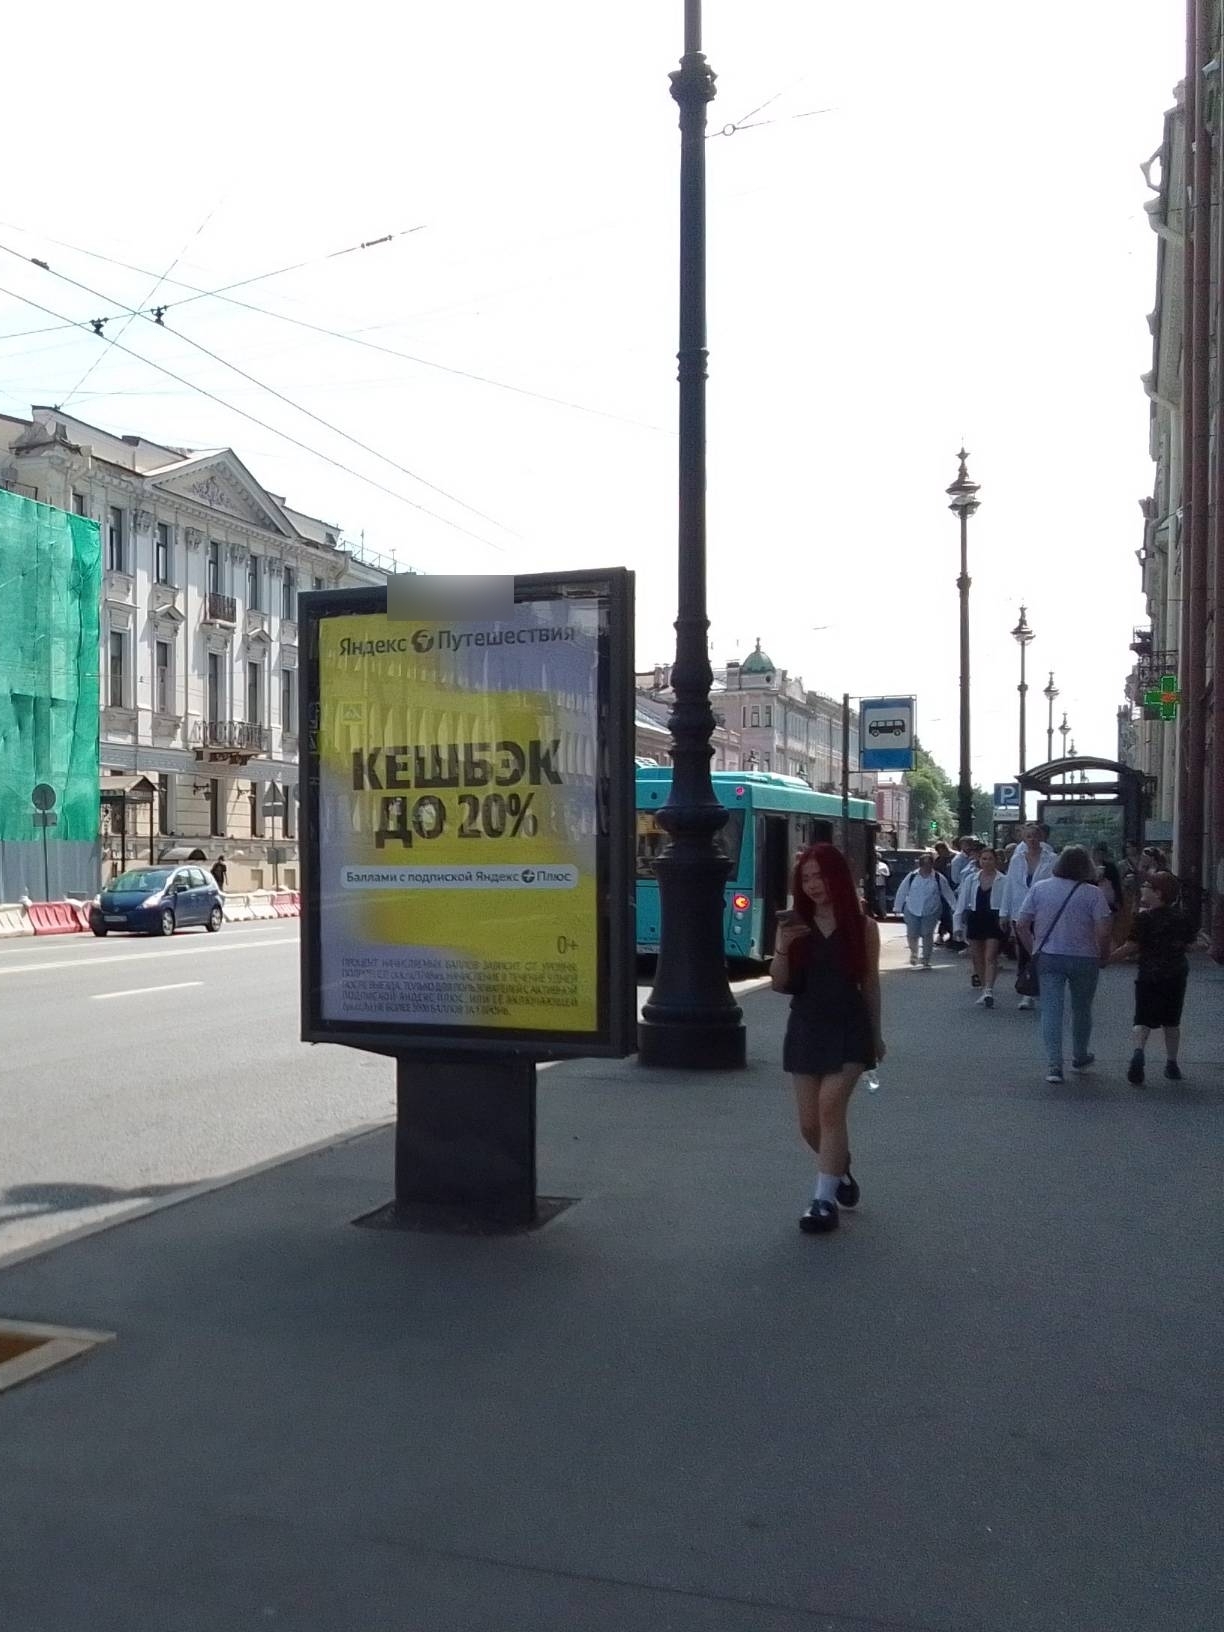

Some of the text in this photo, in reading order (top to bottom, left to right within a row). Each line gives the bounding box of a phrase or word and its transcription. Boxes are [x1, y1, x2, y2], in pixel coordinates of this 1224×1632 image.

[339, 626, 575, 657] Яндекс Путешествия
[352, 739, 563, 791] КЕШБЭК
[376, 792, 538, 848] ДО 20%
[346, 871, 571, 885] Баллами с подпиской Яндекс Плюс
[557, 935, 579, 954] 0+
